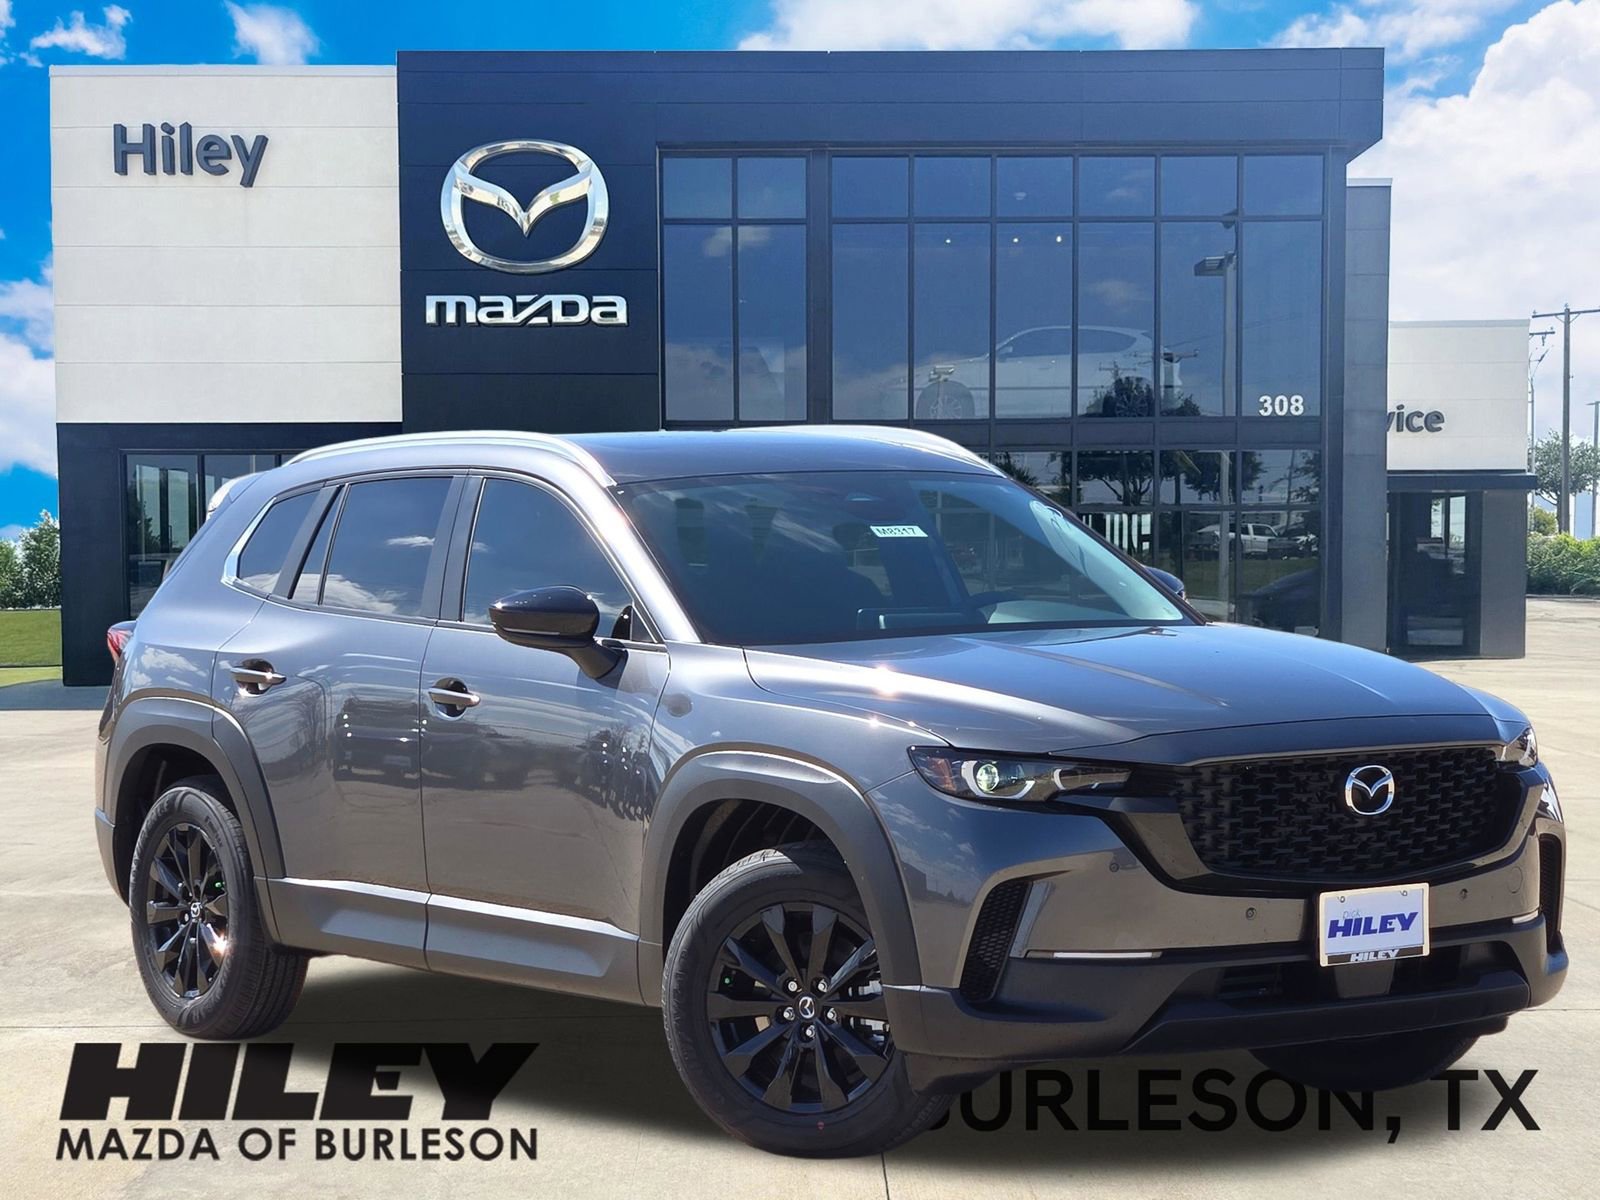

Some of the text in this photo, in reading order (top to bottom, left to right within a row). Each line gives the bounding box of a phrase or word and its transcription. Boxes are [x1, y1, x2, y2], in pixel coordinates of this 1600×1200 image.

[113, 121, 269, 187] Hiley
[1258, 395, 1304, 416] 308
[1328, 912, 1418, 938] HILEY
[1350, 949, 1399, 962] HILEY
